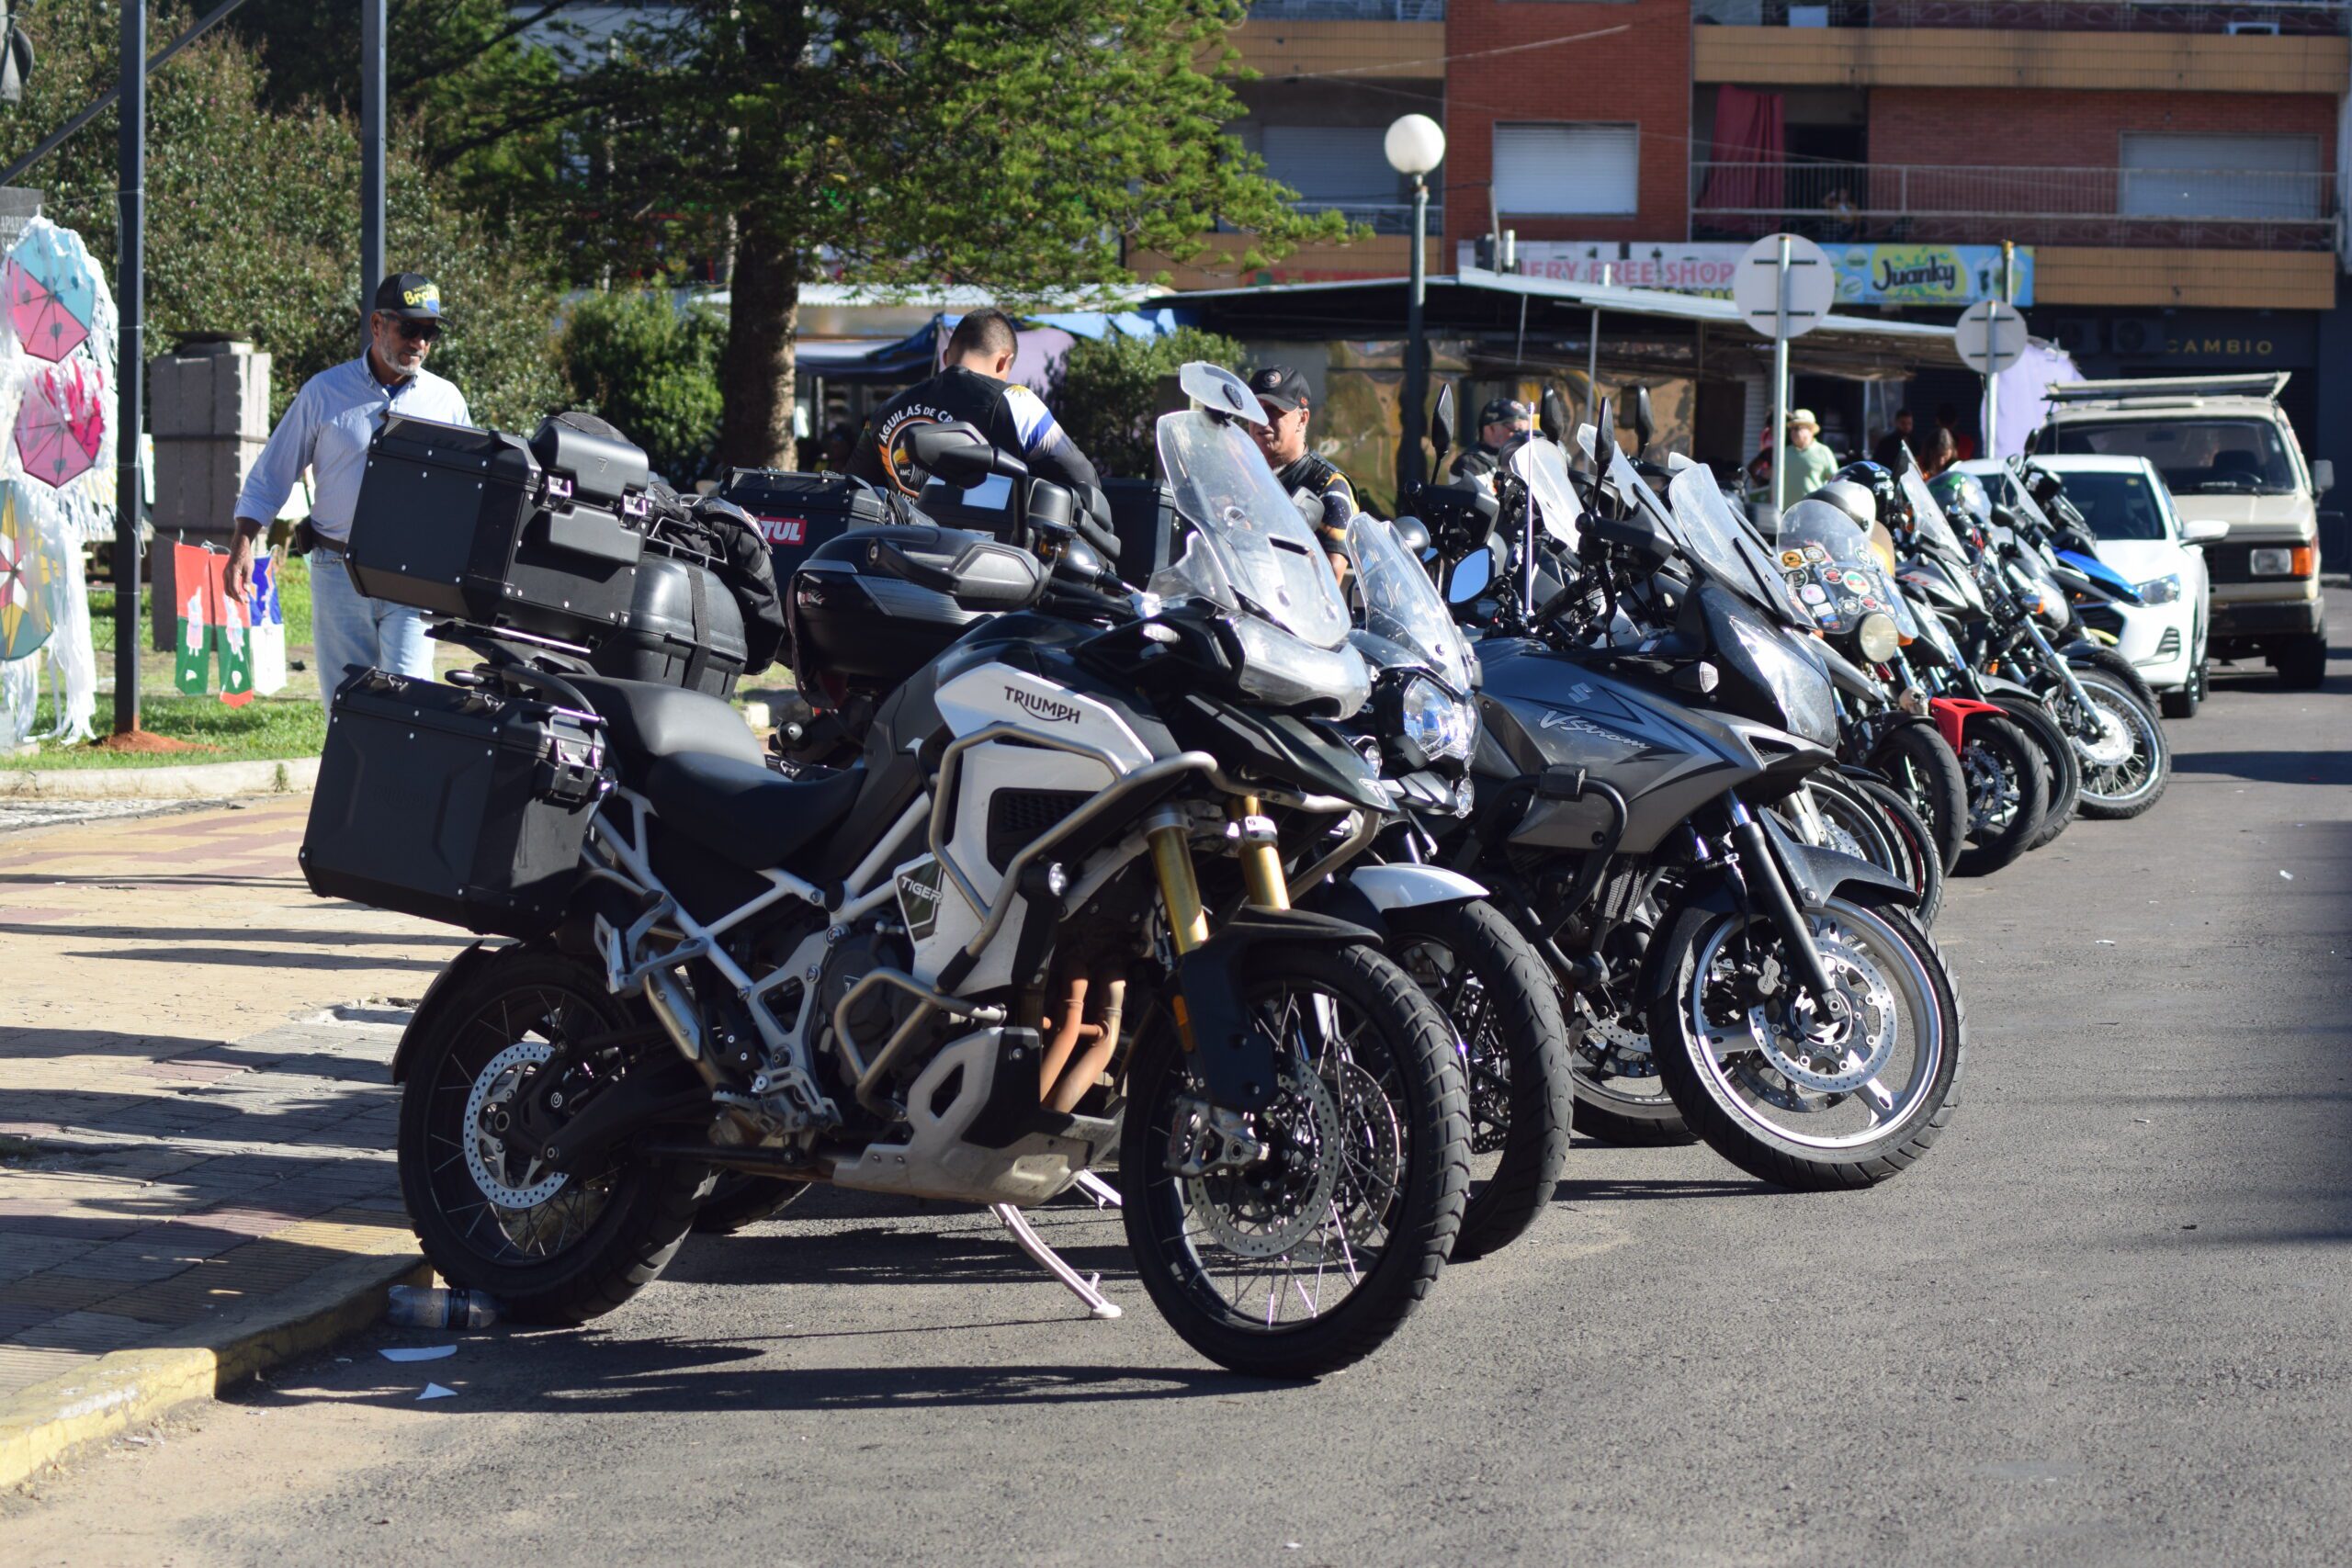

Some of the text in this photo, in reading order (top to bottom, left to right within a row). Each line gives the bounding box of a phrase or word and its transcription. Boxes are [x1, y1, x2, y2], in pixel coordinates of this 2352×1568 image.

[1589, 260, 1655, 285] FREE
[1666, 261, 1736, 285] SHOP
[1872, 254, 1955, 291] Juanky
[2166, 339, 2273, 355] CAMBIO
[922, 406, 937, 417] DE
[1004, 685, 1080, 724] TRIUMPH
[901, 875, 943, 904] TIGER
